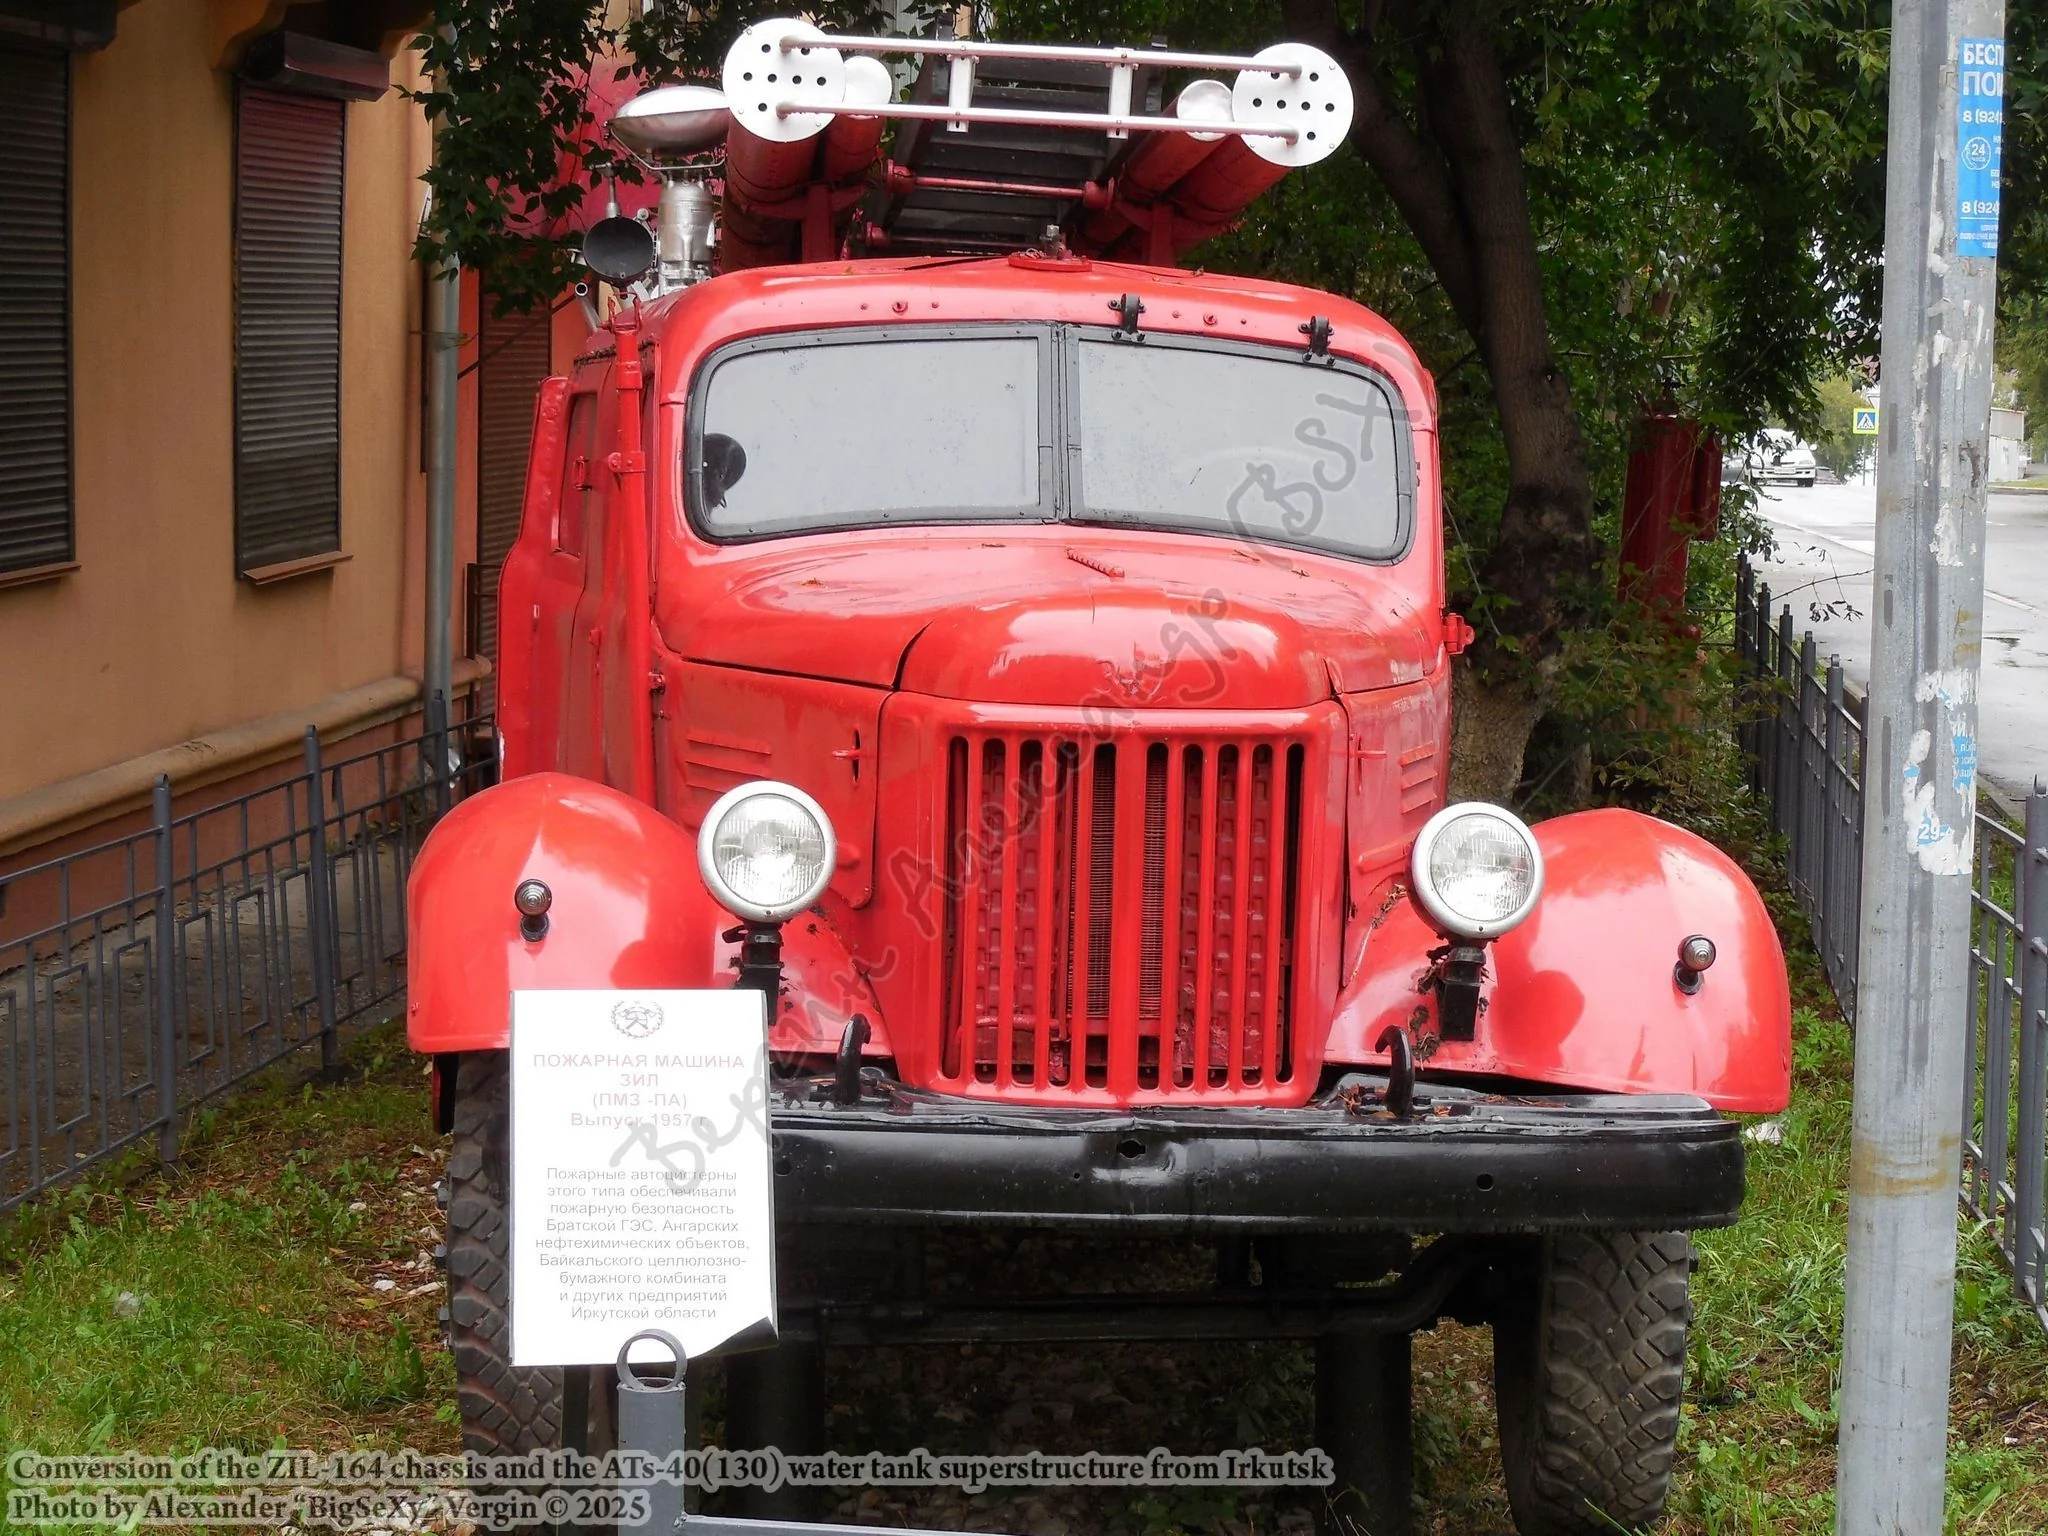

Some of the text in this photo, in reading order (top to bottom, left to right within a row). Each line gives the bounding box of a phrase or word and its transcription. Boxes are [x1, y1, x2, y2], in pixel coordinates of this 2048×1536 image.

[1963, 110, 1972, 123] 8
[1971, 143, 1985, 156] 24
[1961, 201, 1971, 213] 8
[533, 1054, 746, 1069] ПОЖАРНАЯ МАШИНА
[619, 1073, 660, 1087] ЗИЛ
[592, 1093, 688, 1110] (ПМЗ -ПА)
[570, 1112, 643, 1130] Выпуск
[651, 1113, 692, 1127] 1957
[546, 1167, 738, 1184] Пожарные автоцистерны
[546, 1184, 738, 1199] этого типа обеспечивали
[550, 1201, 735, 1218] пожарную безопасность
[545, 1218, 617, 1234] Братской
[661, 1219, 739, 1234] Ангарских
[534, 1236, 672, 1251] нефтехимических
[539, 1253, 748, 1268] Байкальского целлюлозно-
[558, 1271, 728, 1287] бумажного комбината
[559, 1289, 728, 1305] и других предприятий
[570, 1306, 717, 1322] Иркутской области
